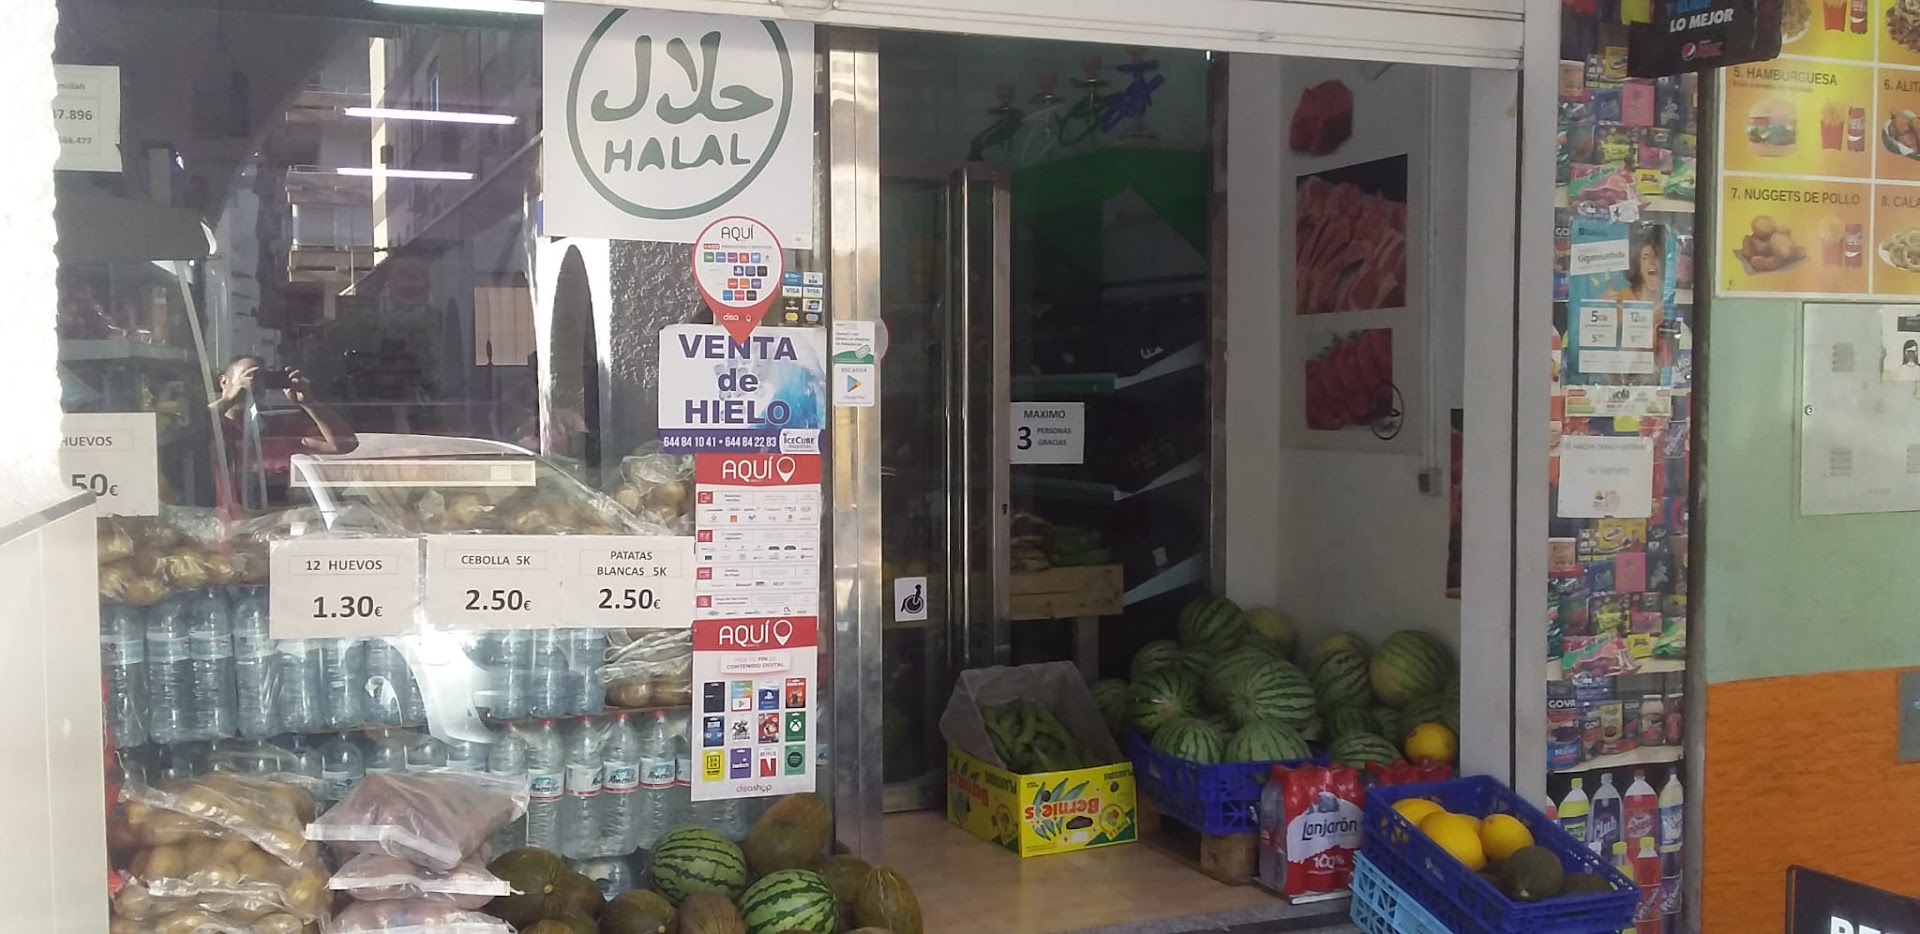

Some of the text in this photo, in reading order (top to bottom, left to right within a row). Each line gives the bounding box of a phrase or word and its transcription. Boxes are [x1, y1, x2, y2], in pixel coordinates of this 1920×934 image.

[1669, 8, 1734, 32] LO MEJOR
[591, 31, 774, 124] حلال
[1734, 67, 1743, 78] 5.
[1747, 68, 1837, 86] HAMBURGUESA
[1884, 80, 1893, 91] 6.
[604, 133, 751, 174] HALAL
[1731, 187, 1860, 205] 7. NUGGETS DE POLLO
[721, 225, 754, 241] AQUÍ
[678, 334, 798, 361] VENTA
[717, 367, 759, 392] de
[684, 399, 791, 425] HIELO
[1023, 410, 1066, 419] MAXIMO
[663, 436, 679, 447] 644
[681, 436, 692, 447] 84
[695, 436, 704, 447] 10
[706, 436, 716, 447] 41
[725, 436, 741, 447] 644
[742, 436, 753, 447] 84
[754, 436, 765, 447] 22
[766, 436, 777, 447] 83
[1017, 426, 1032, 450] 3
[722, 456, 774, 482] AQUÍ
[306, 559, 382, 571] 12 HUEVOS
[461, 554, 531, 566] CEBOLLA 5K
[610, 550, 653, 561] PATATAS
[596, 566, 667, 577] BLANCAS 5K
[312, 595, 383, 619] 1.30€
[464, 588, 532, 612] 2.50€
[598, 588, 661, 611] 2.50€
[719, 620, 771, 647] AQUÍ
[1301, 817, 1358, 842] Lanjarón
